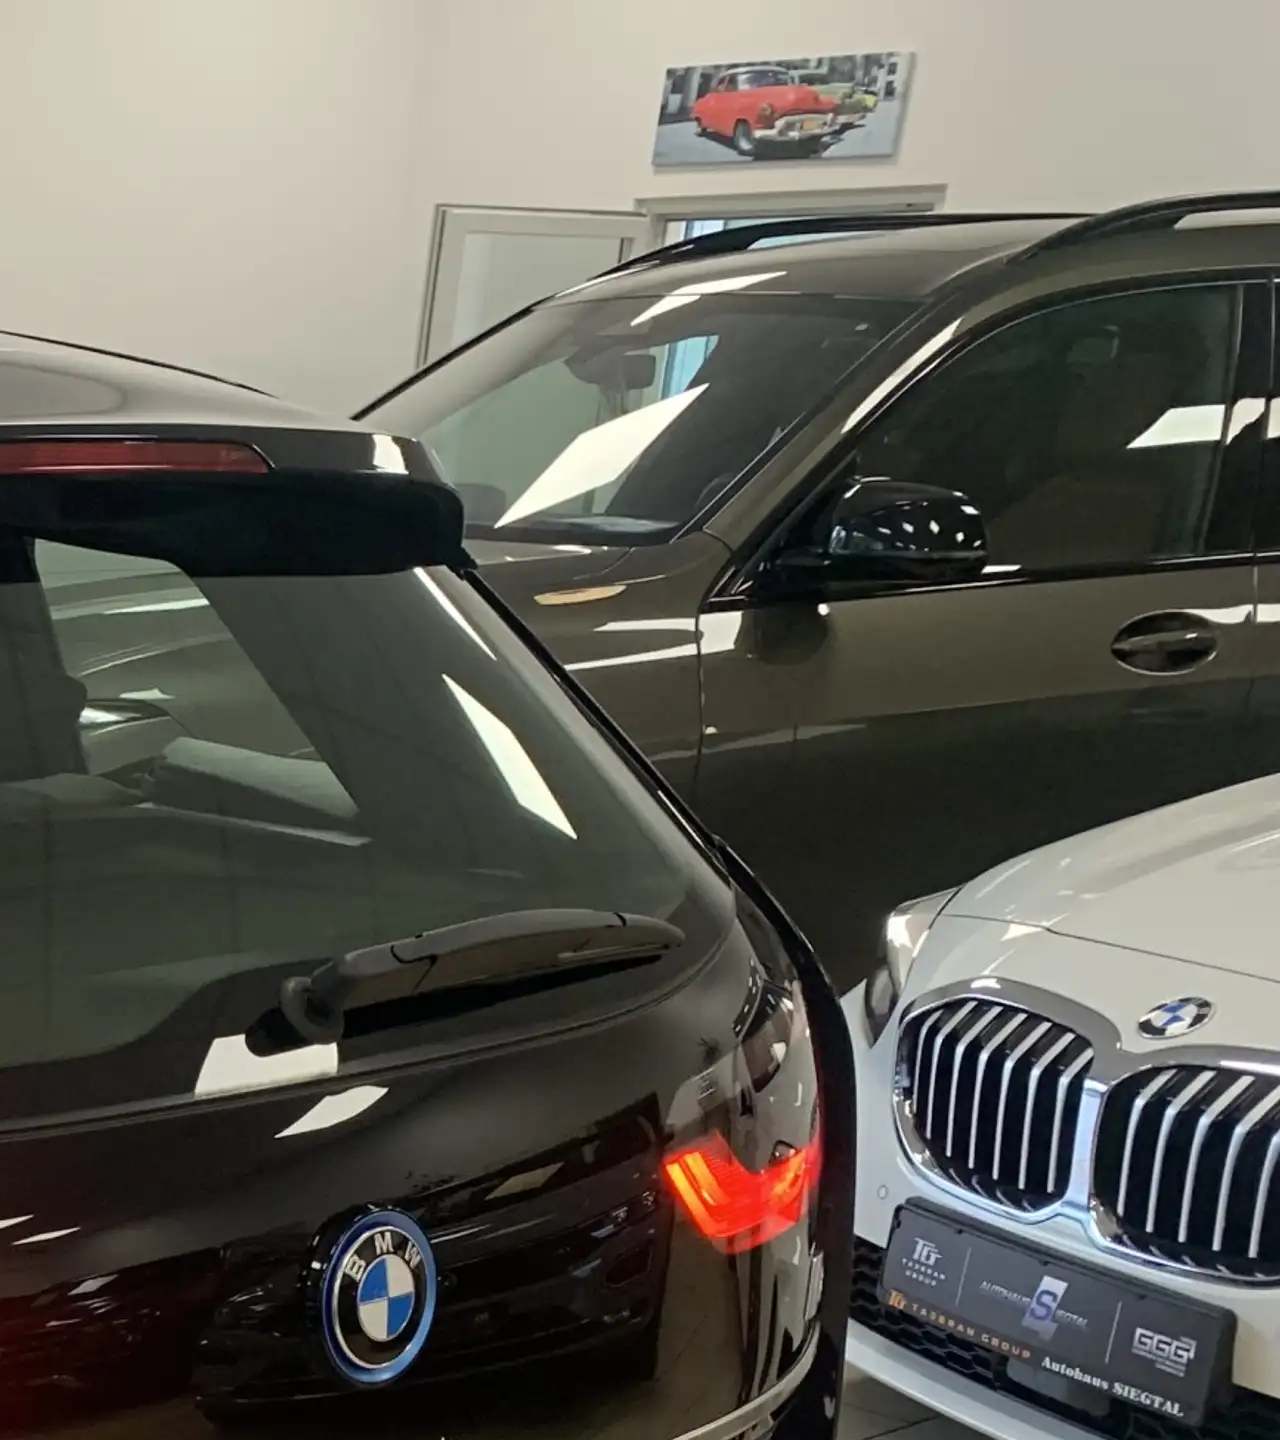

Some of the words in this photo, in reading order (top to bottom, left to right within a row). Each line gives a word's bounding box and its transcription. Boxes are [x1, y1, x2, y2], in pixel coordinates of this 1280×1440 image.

[344, 1231, 422, 1282] BMW
[1041, 1355, 1110, 1391] Autohaus
[1112, 1381, 1184, 1417] SIEGTAL
